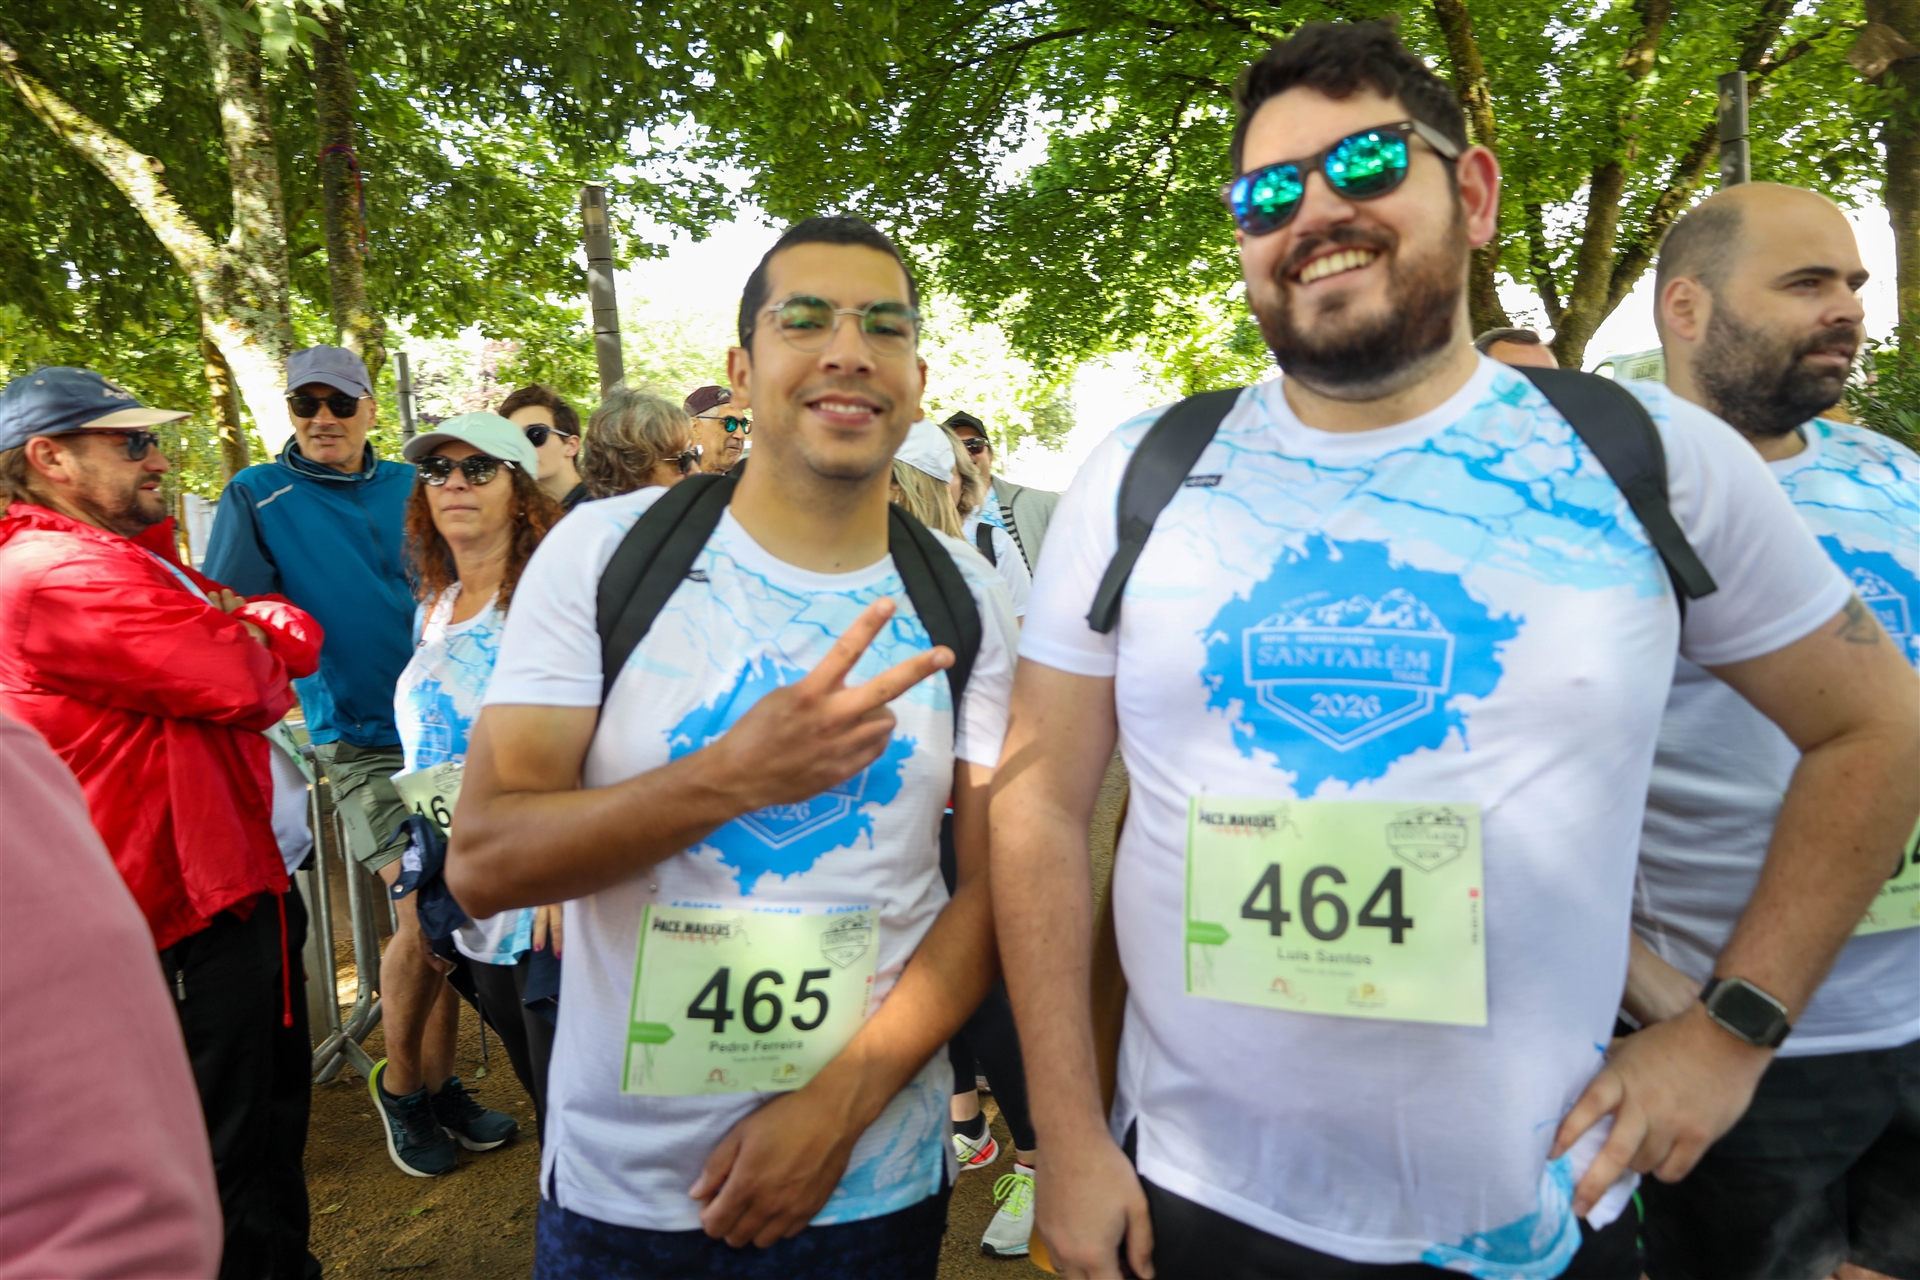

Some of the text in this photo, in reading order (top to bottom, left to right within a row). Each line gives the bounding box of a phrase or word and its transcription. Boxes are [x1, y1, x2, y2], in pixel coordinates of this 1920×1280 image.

[1257, 644, 1431, 671] SANTARÉM
[1309, 692, 1382, 719] 2026
[1240, 861, 1414, 945] 464
[1316, 949, 1373, 966] Santos
[686, 966, 831, 1034] 465
[709, 1039, 804, 1054] Pedro Ferreira
